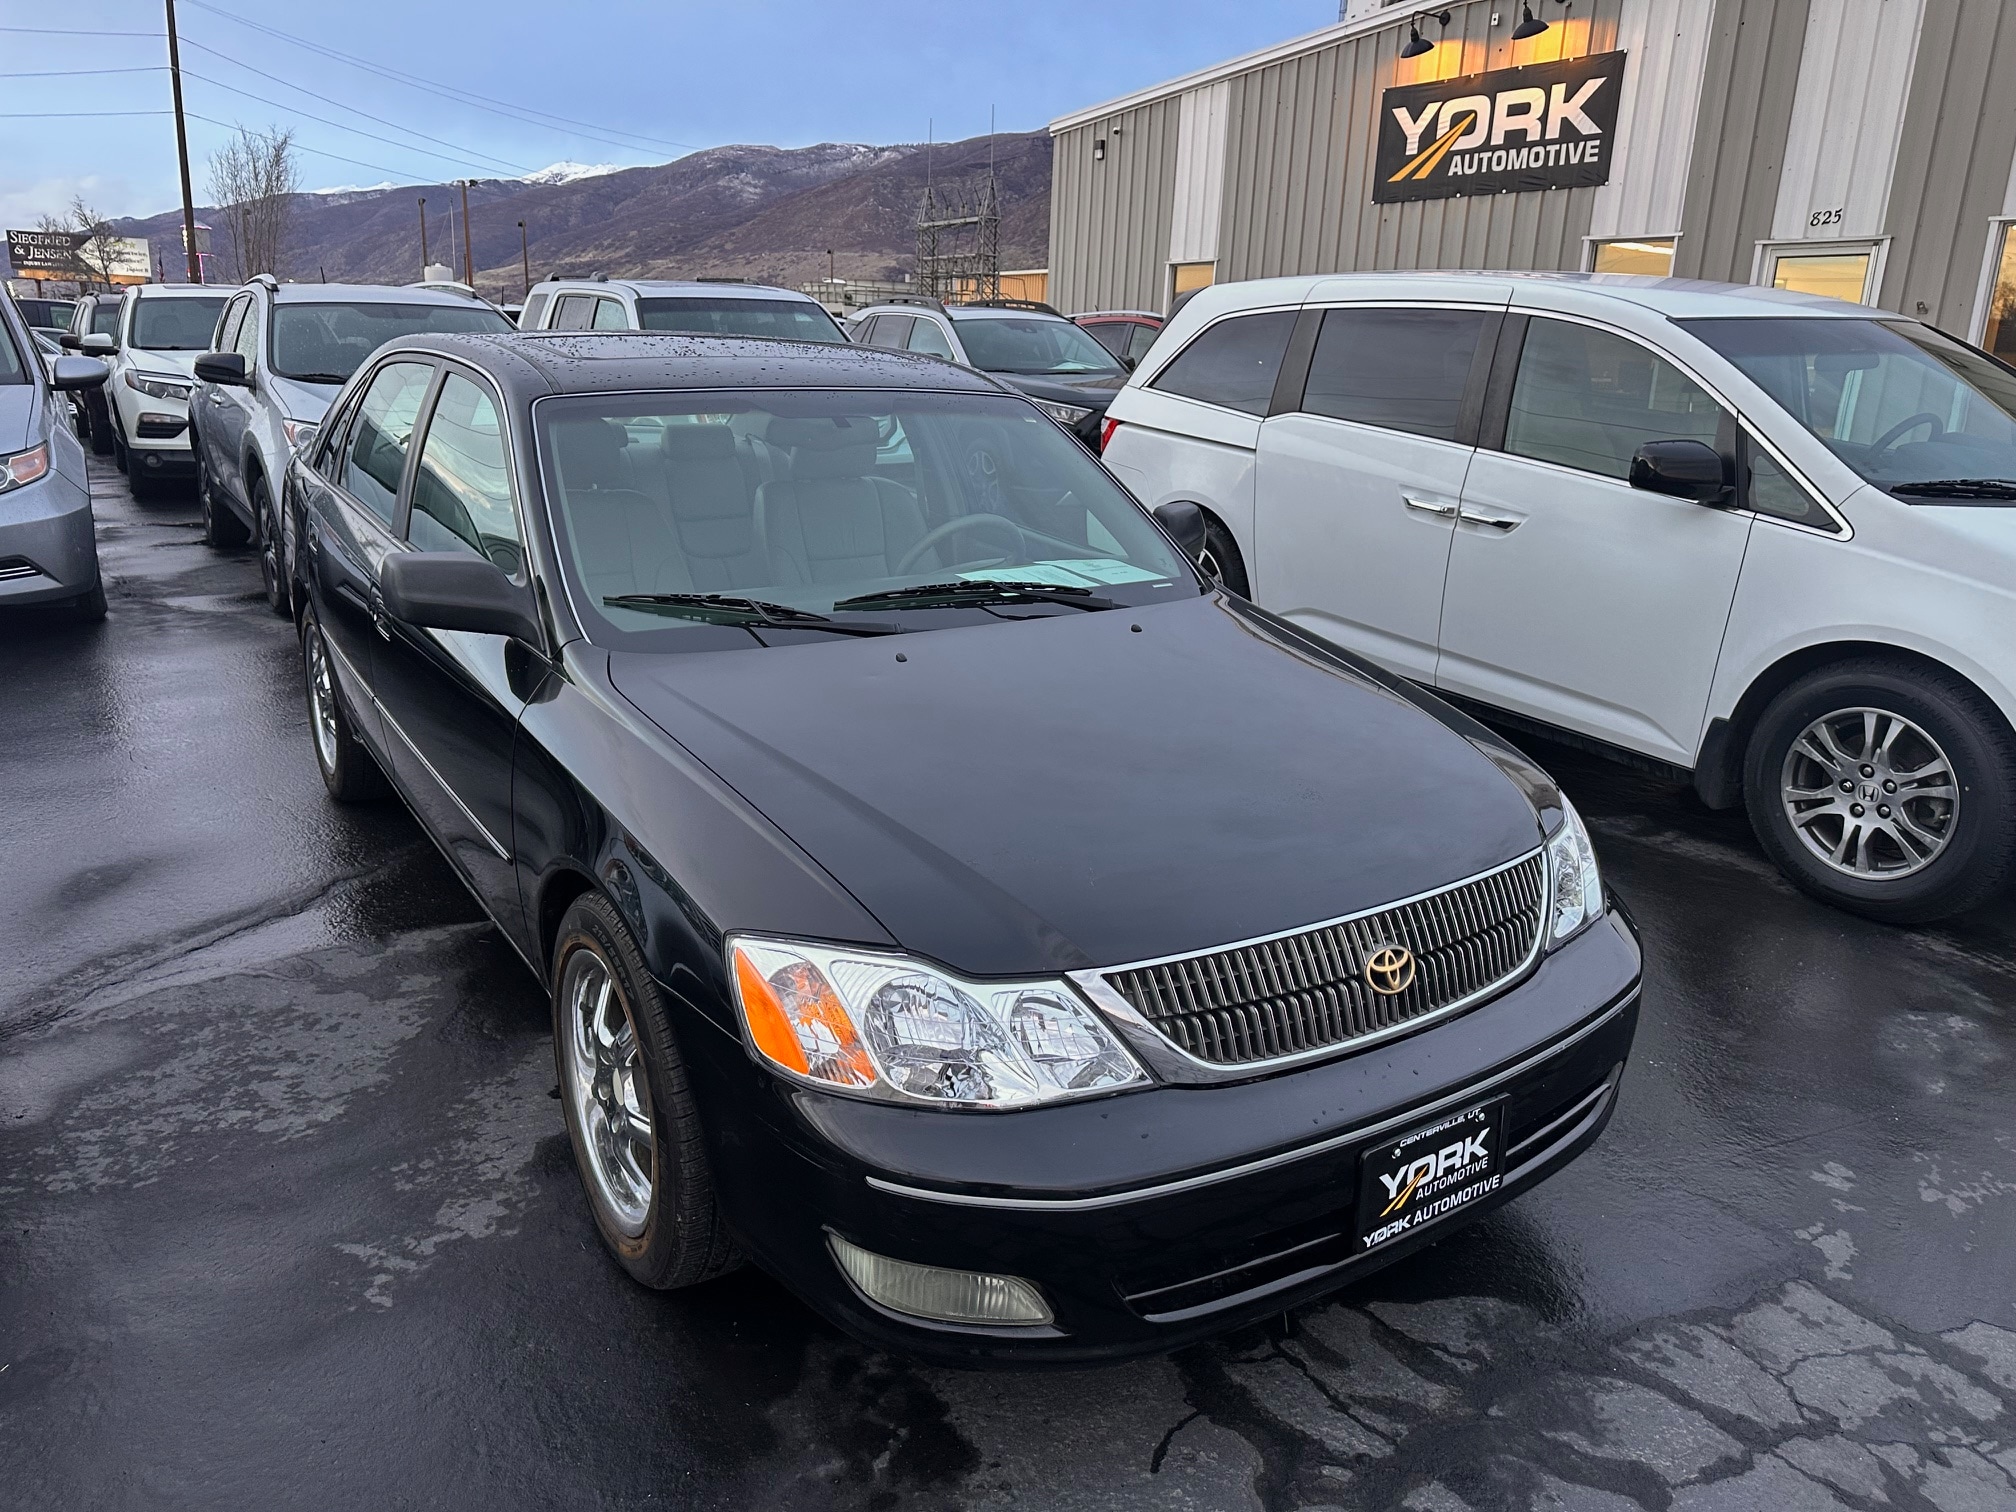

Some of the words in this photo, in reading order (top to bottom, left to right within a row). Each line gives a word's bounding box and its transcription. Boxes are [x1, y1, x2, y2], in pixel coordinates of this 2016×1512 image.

[1392, 77, 1607, 155] YORK
[1448, 139, 1600, 176] AUTOMOTIVE
[1810, 208, 1842, 226] 825
[10, 230, 71, 246] SIEGFRIED
[14, 244, 25, 255] &
[27, 246, 72, 260] JENSEN
[1400, 1114, 1465, 1147] CENTERVILLE,
[1468, 1108, 1481, 1119] UT
[1379, 1127, 1490, 1199] YORK
[1416, 1156, 1488, 1200] AUTOMOTIVE
[1363, 1214, 1411, 1247] YORK
[1413, 1173, 1500, 1225] AUTOMOTIVE
